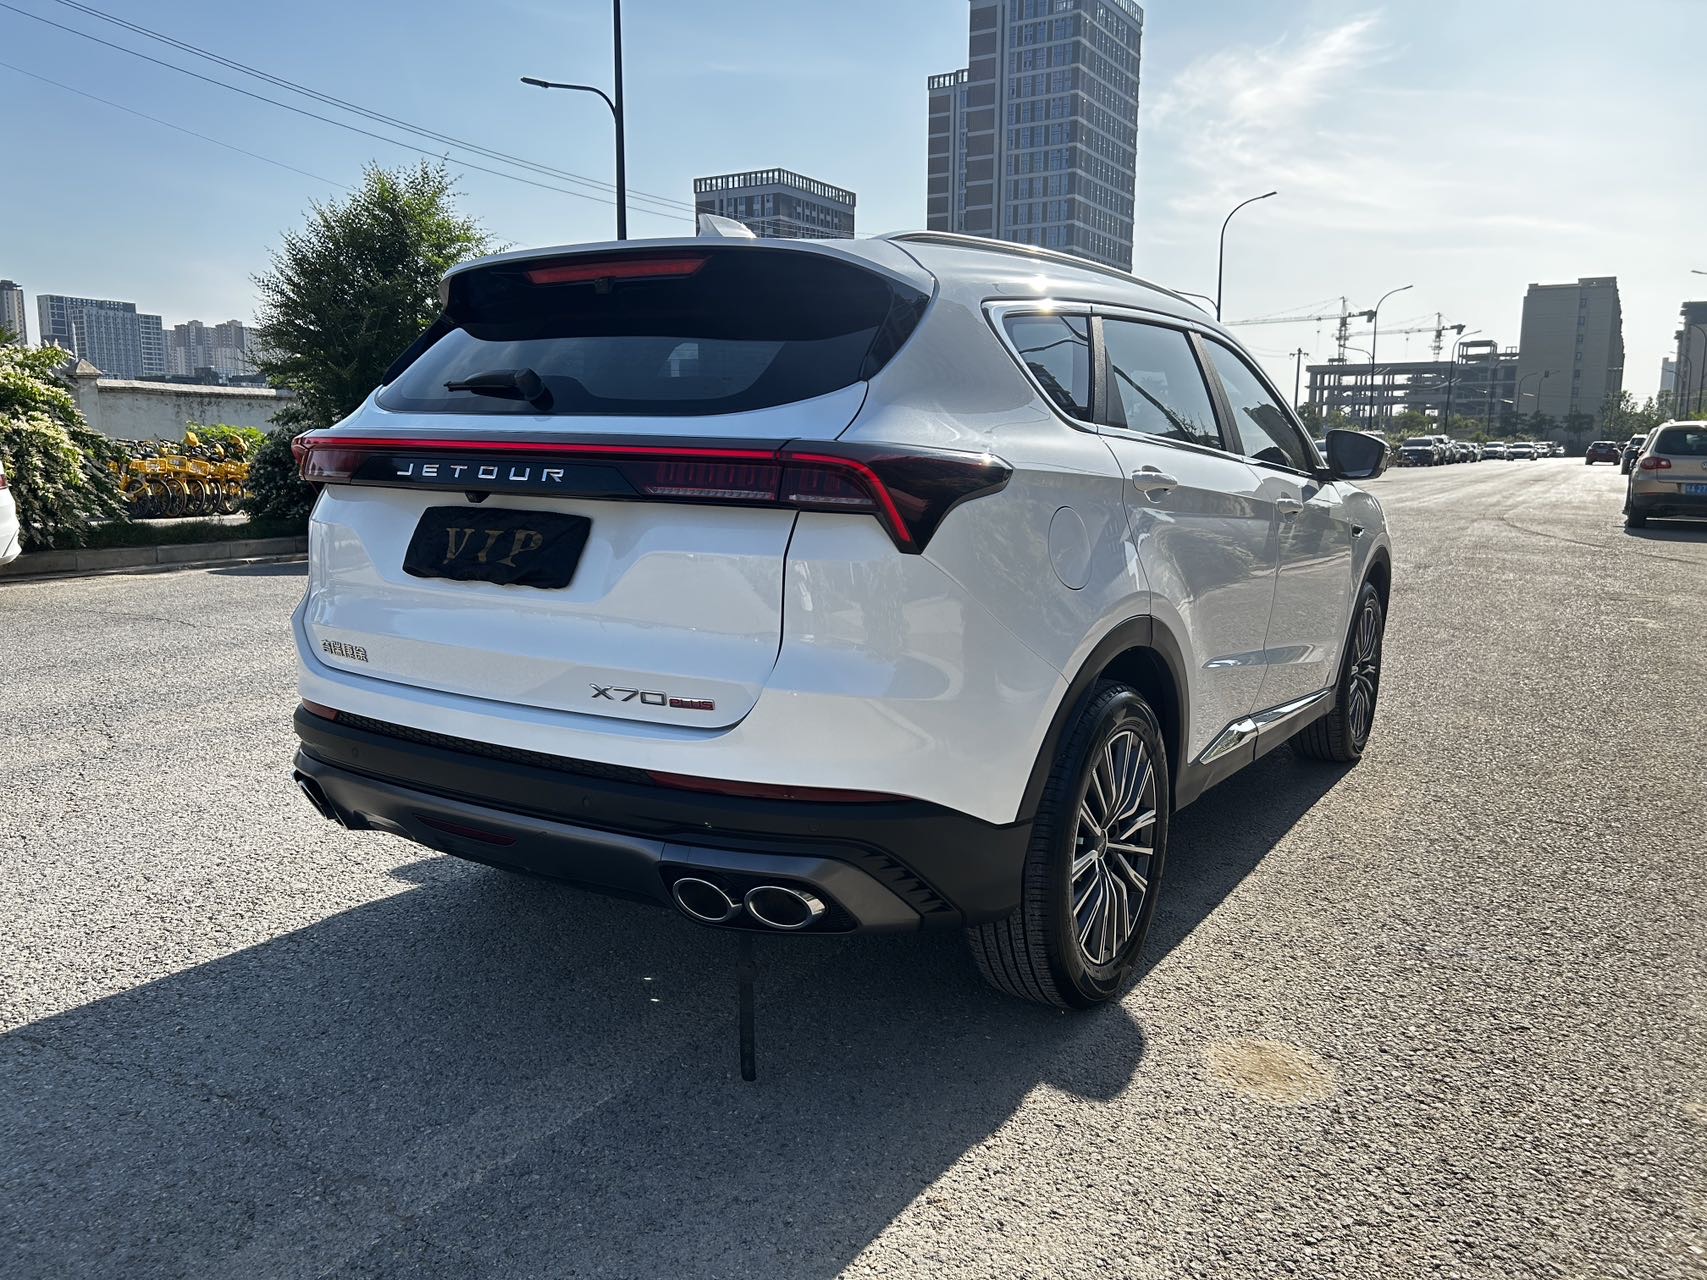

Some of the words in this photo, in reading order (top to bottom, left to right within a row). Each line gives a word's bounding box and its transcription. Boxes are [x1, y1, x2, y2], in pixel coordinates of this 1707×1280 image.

[396, 463, 564, 482] JETOUR
[442, 527, 544, 567] VIP
[589, 683, 667, 706] X70
[669, 696, 715, 710] PLUS
